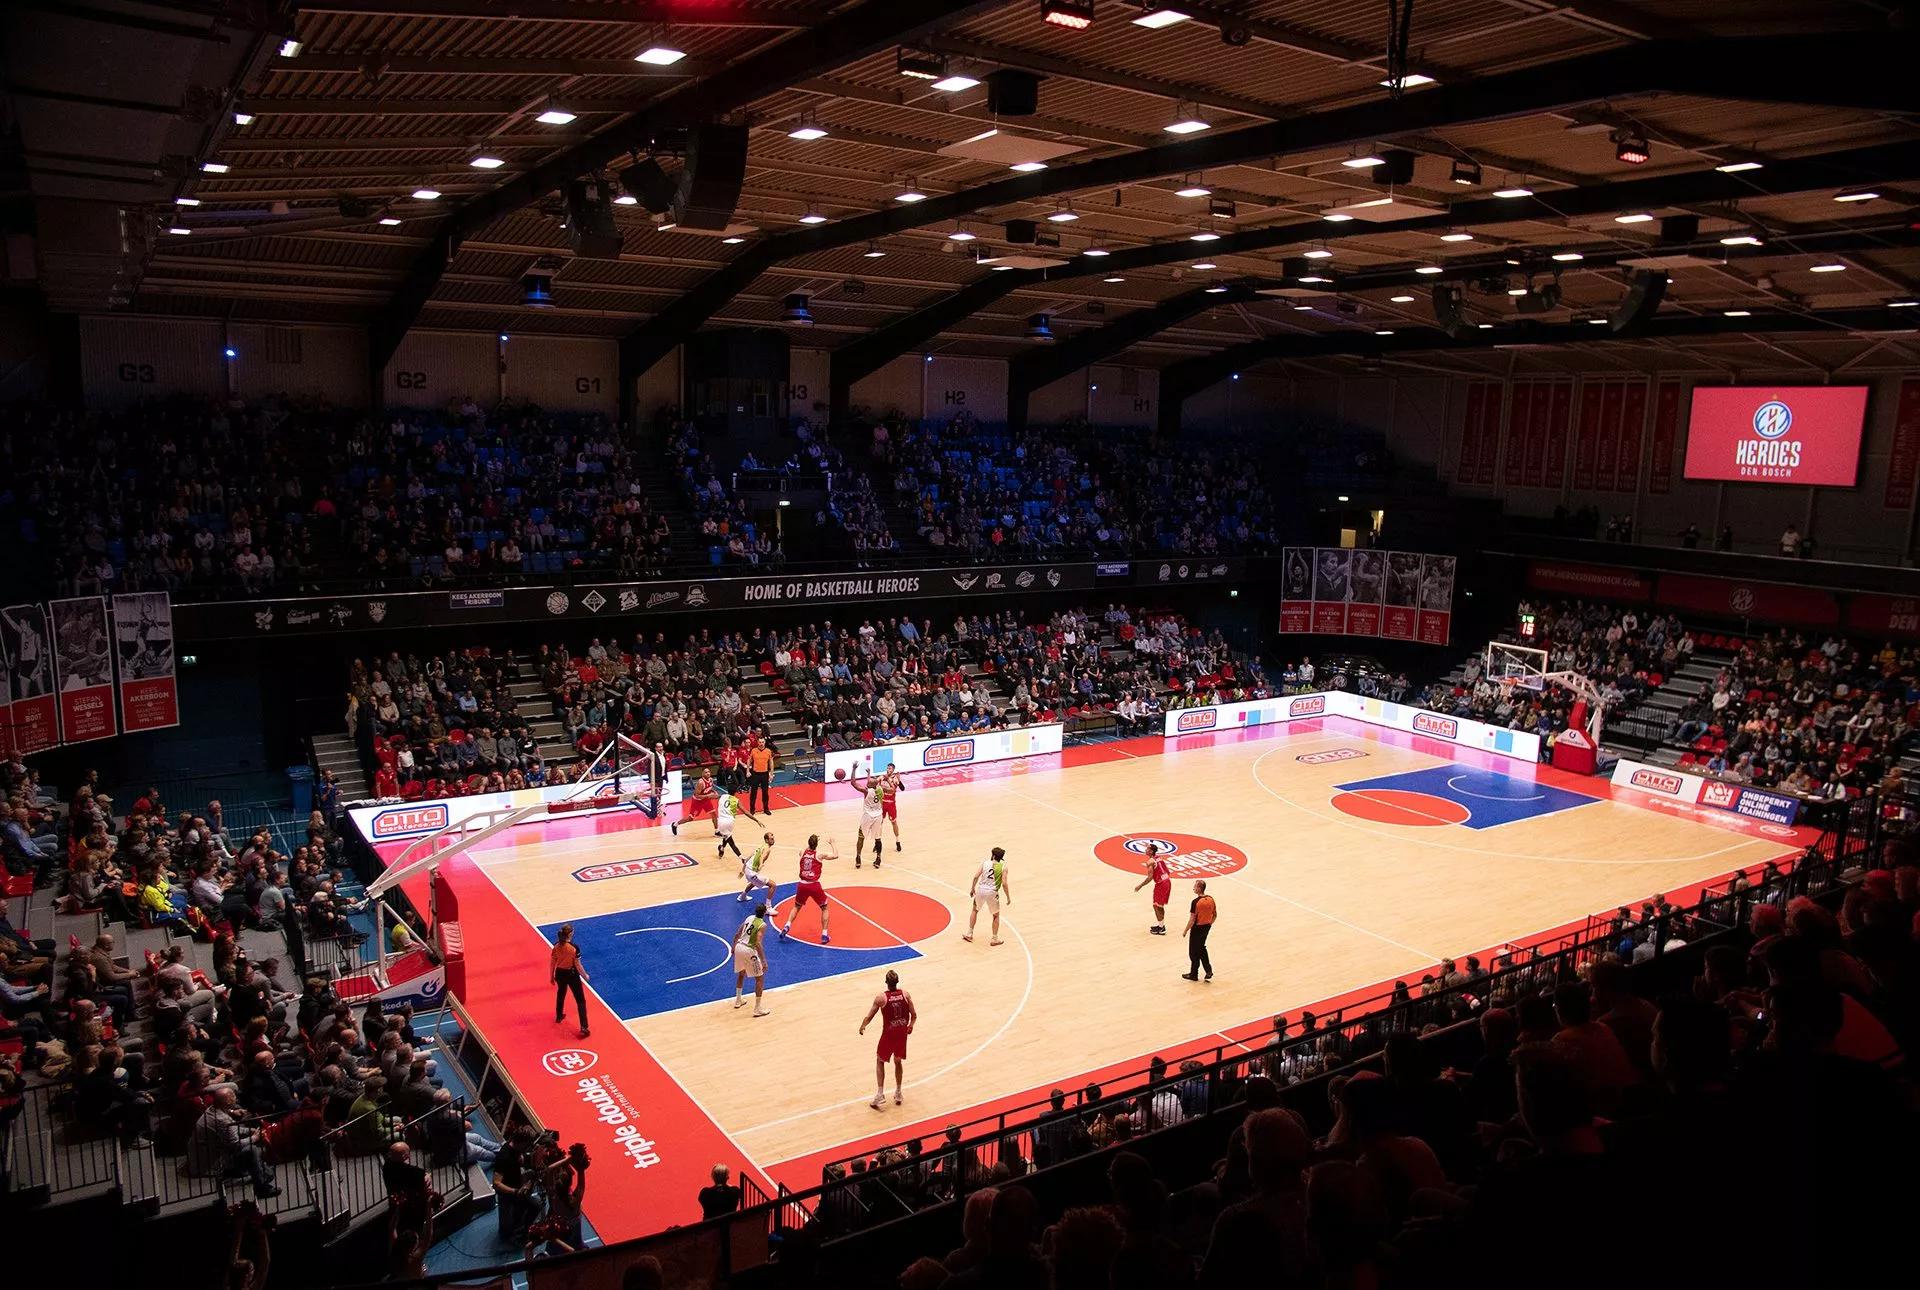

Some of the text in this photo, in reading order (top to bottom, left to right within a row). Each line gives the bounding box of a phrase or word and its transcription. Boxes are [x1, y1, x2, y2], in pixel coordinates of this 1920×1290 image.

[119, 363, 154, 382] G3
[397, 371, 426, 389] G2
[576, 377, 601, 393] G1
[784, 385, 808, 399] H3
[945, 390, 966, 405] H2
[1133, 399, 1150, 412] H1
[1735, 440, 1801, 467] HEROES
[1740, 467, 1791, 478] DEN BOSCH
[469, 592, 502, 600] AKERBOOM
[744, 577, 920, 601] HOME OF BASKETBALL HEROES
[1522, 623, 1535, 635] 15
[73, 696, 102, 706] STEFAN
[129, 692, 169, 702] AKERBOOM
[72, 701, 104, 712] WESSELS
[928, 744, 970, 757] OTTO
[1740, 799, 1770, 812] ONLINE
[1742, 791, 1792, 809] ONBEPERKT
[380, 809, 442, 828] OTTO
[1737, 805, 1787, 823] TRAININGEN
[380, 821, 442, 833] workforce.eu
[987, 869, 995, 879] 2
[599, 1074, 641, 1119] sportmarketing
[576, 1077, 661, 1169] triple double
